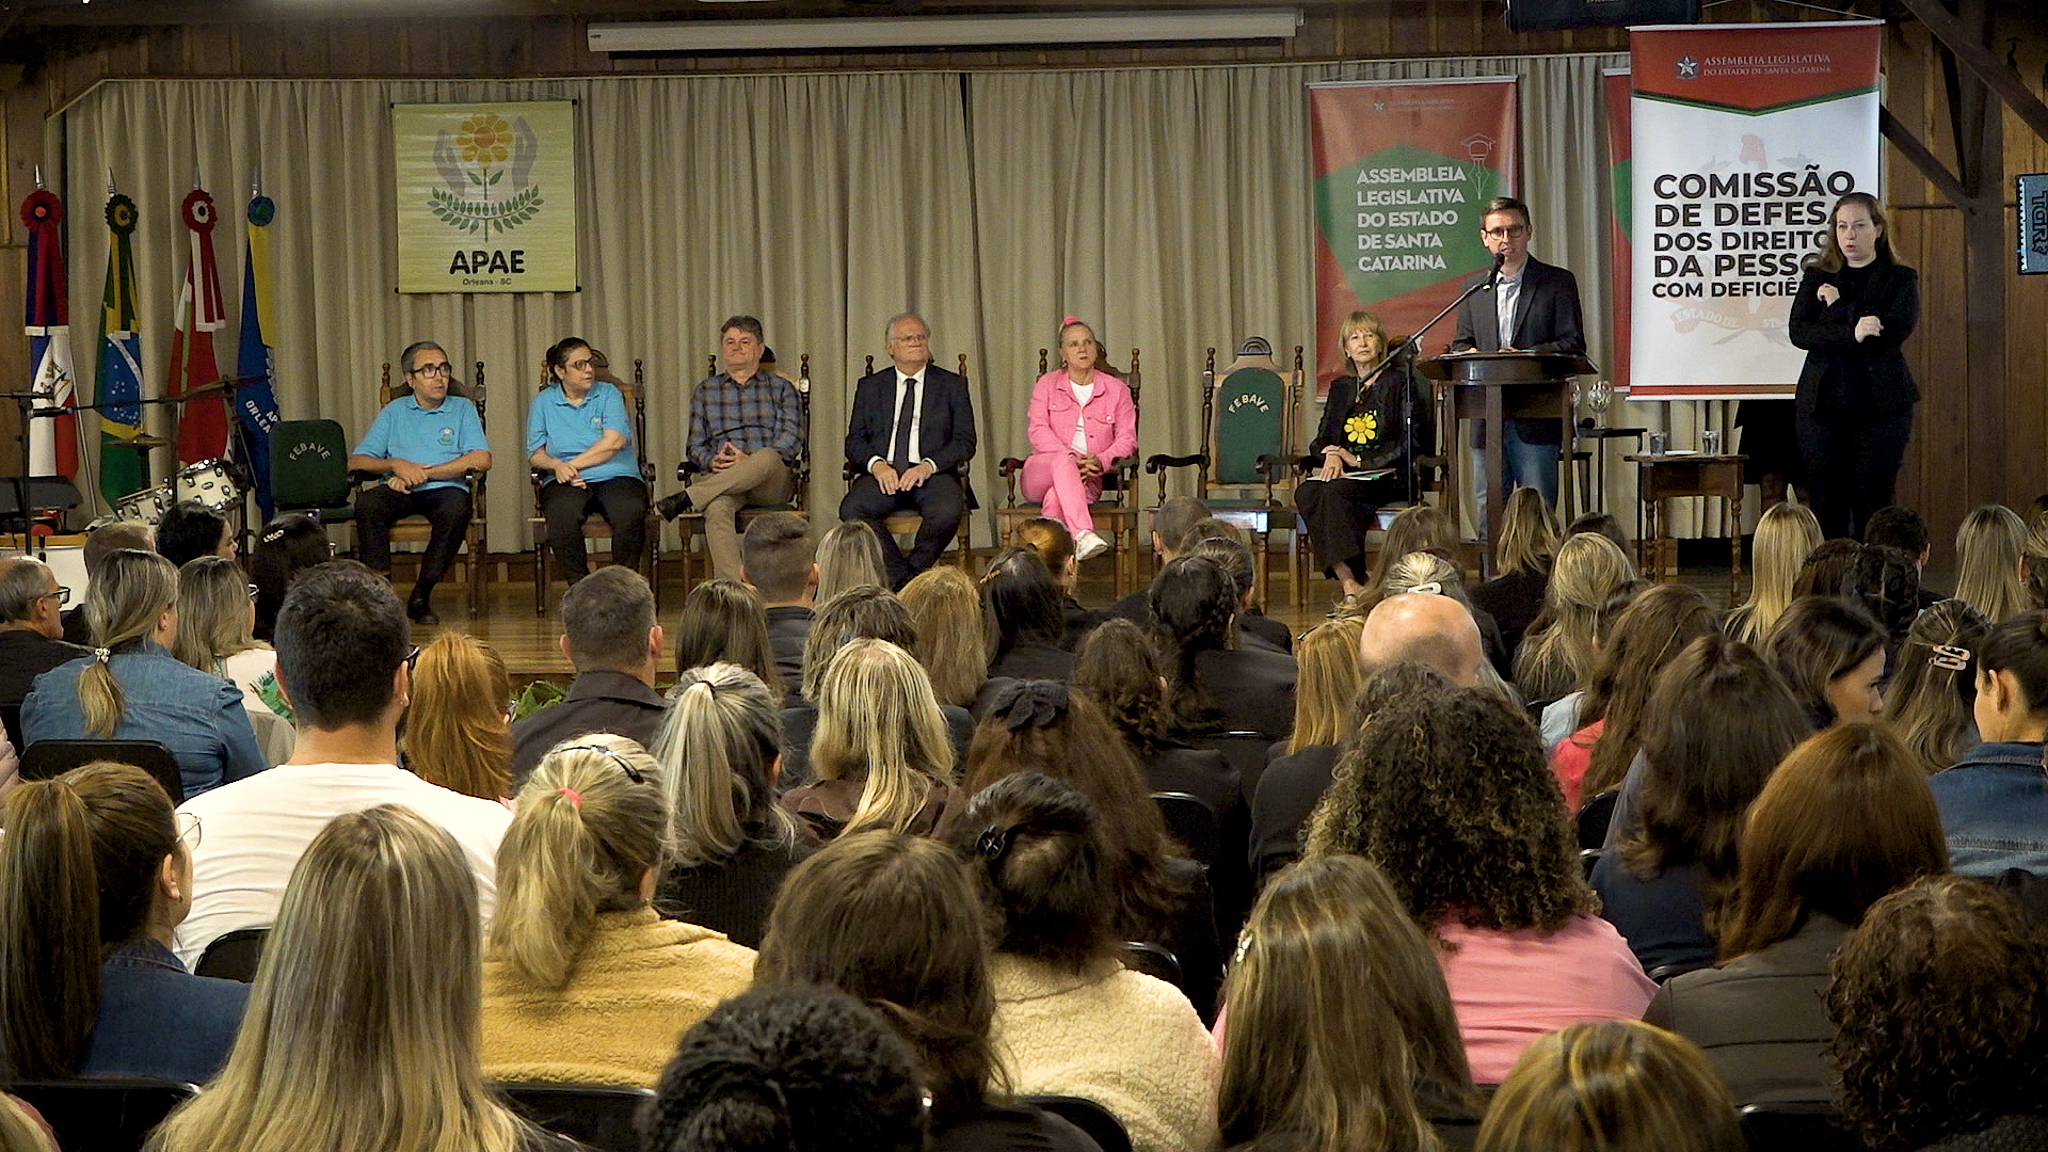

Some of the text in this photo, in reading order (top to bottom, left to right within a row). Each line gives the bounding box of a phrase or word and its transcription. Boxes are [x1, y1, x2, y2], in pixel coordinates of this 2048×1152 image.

[1704, 54, 1831, 66] ASSEMBLEIA LEGISLATIVA
[1703, 66, 1832, 76] DO ESTADO DE SANTA CATARINA
[1356, 166, 1467, 185] ASSEMBLEIA
[1653, 163, 1855, 199] COMISSÃO
[1357, 188, 1466, 206] LEGISLATIVA
[1357, 210, 1459, 228] DO ESTADO
[1655, 201, 1832, 227] DE DEFES
[1357, 232, 1444, 250] DE SANTA
[1654, 230, 1829, 251] DOS DIREITO
[449, 250, 526, 275] APAE
[1358, 254, 1447, 272] CATARINA
[1654, 255, 1704, 278] DA
[462, 278, 494, 286] Orleans
[500, 277, 512, 286] SC
[1652, 277, 1798, 298] COM DEFICIÊ
[1228, 393, 1270, 414] FEBAVE
[245, 399, 272, 433] ORLEA
[289, 442, 331, 461] FEBAVE
